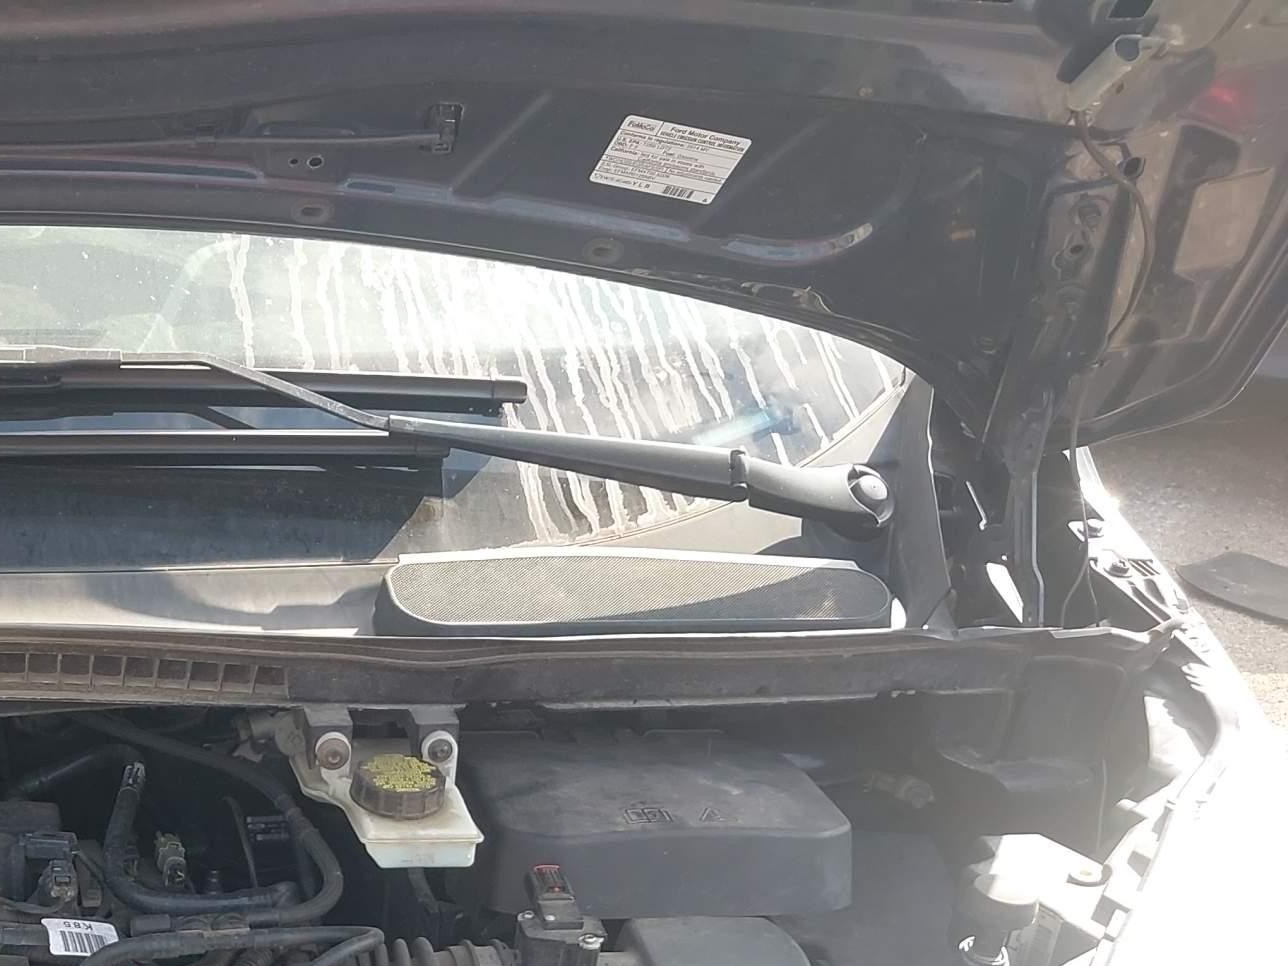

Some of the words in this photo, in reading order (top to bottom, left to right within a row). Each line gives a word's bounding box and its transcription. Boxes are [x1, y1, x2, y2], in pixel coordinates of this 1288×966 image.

[670, 127, 688, 135] Ford
[688, 130, 708, 139] Motor
[709, 134, 741, 146] Company
